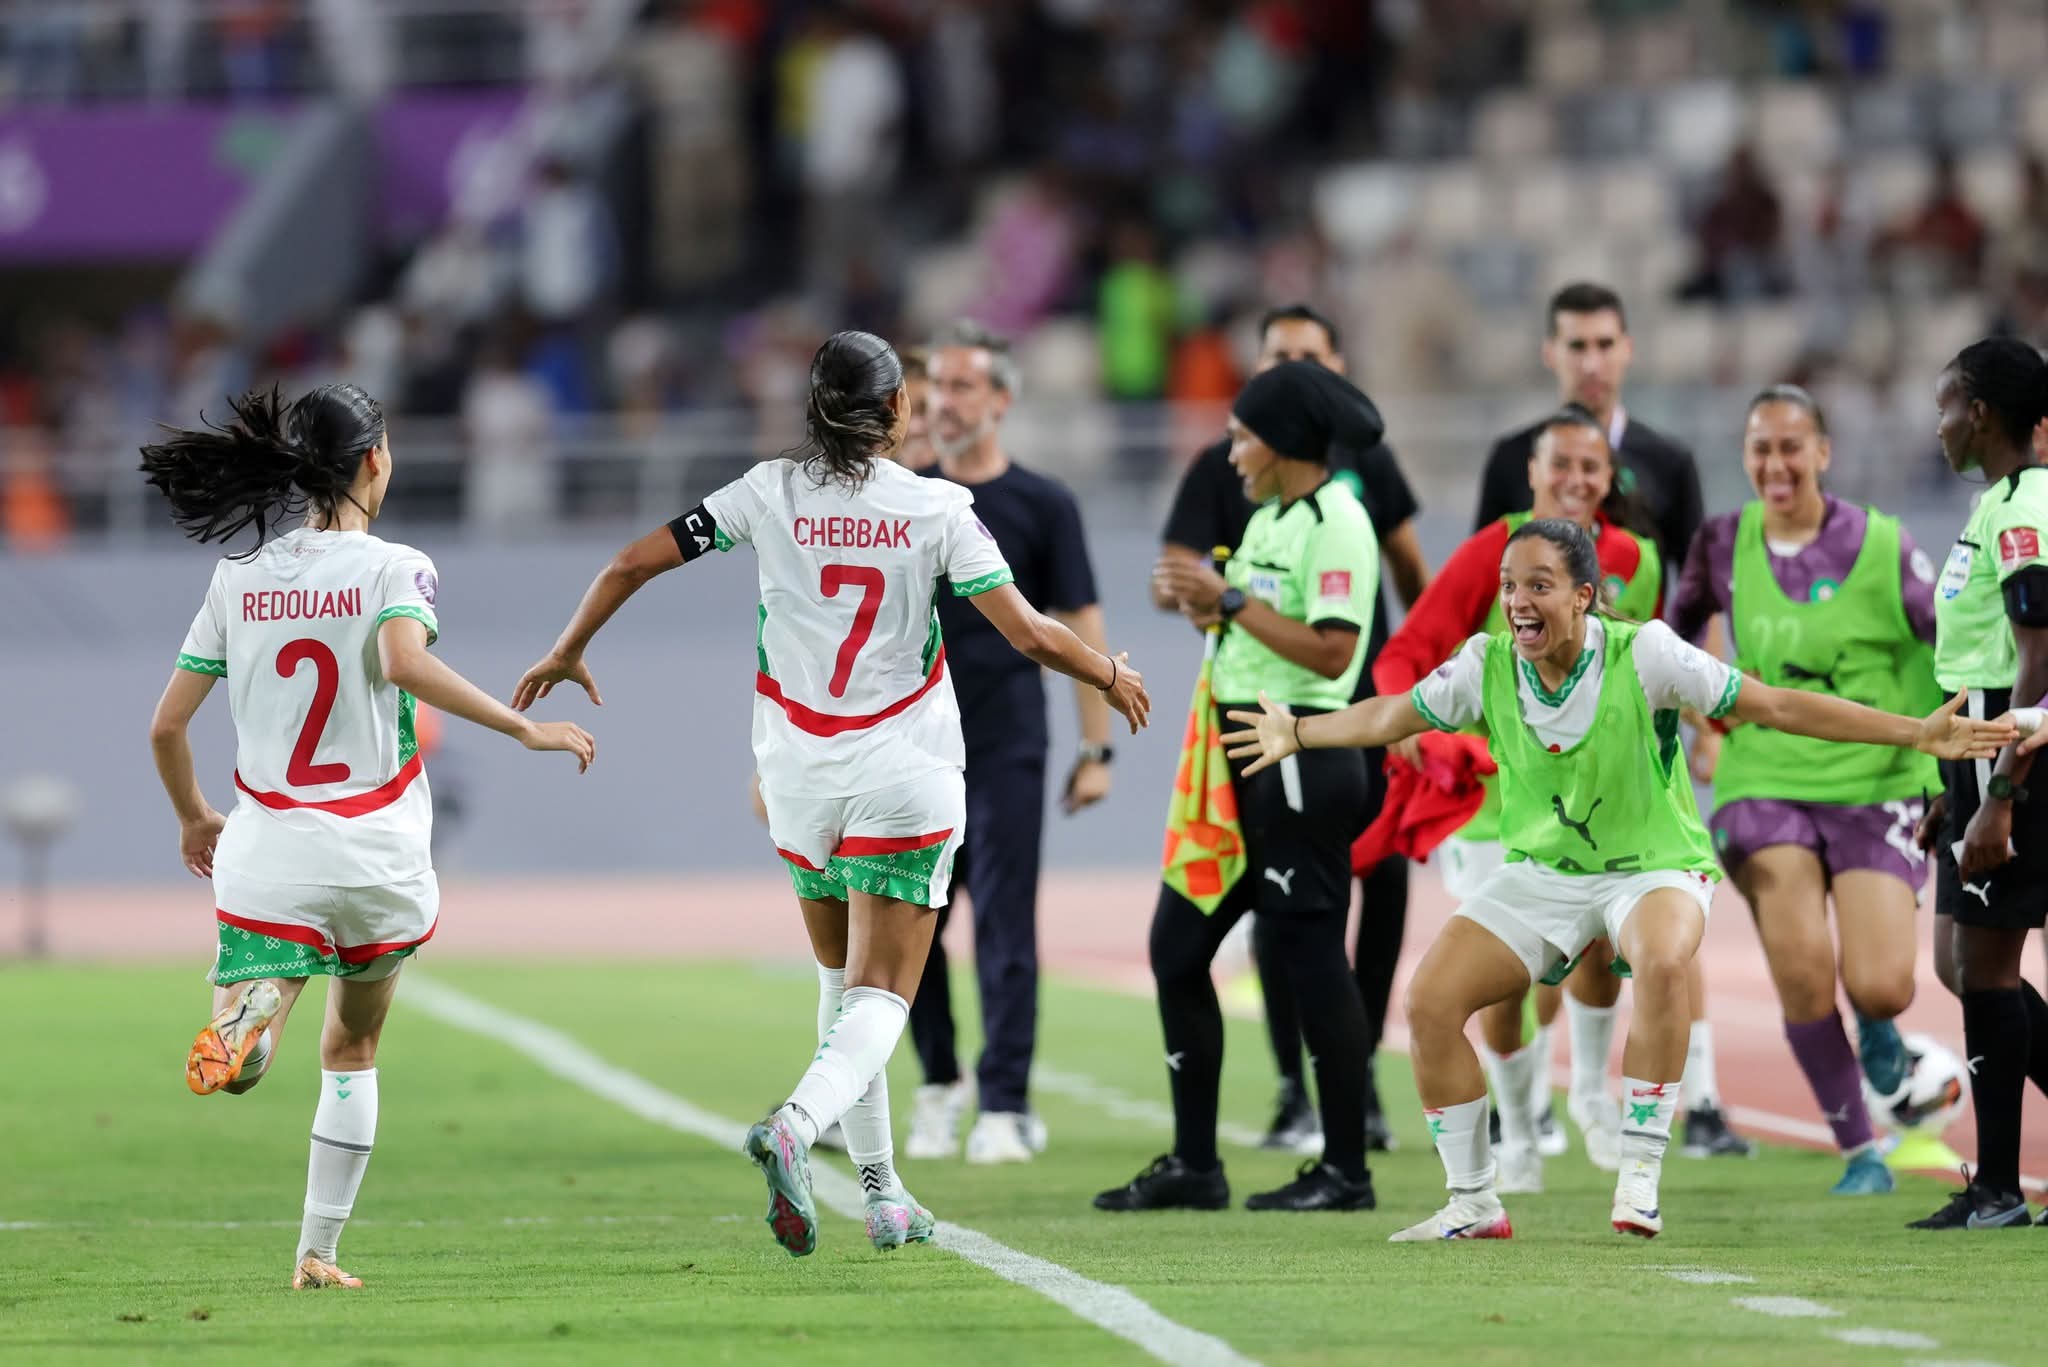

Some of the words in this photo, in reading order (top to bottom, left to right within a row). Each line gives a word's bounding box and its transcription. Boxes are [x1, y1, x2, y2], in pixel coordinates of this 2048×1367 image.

[794, 516, 911, 549] CHEBBAK
[243, 587, 361, 622] REDOUANI
[820, 564, 885, 698] 7
[276, 638, 351, 787] 2
